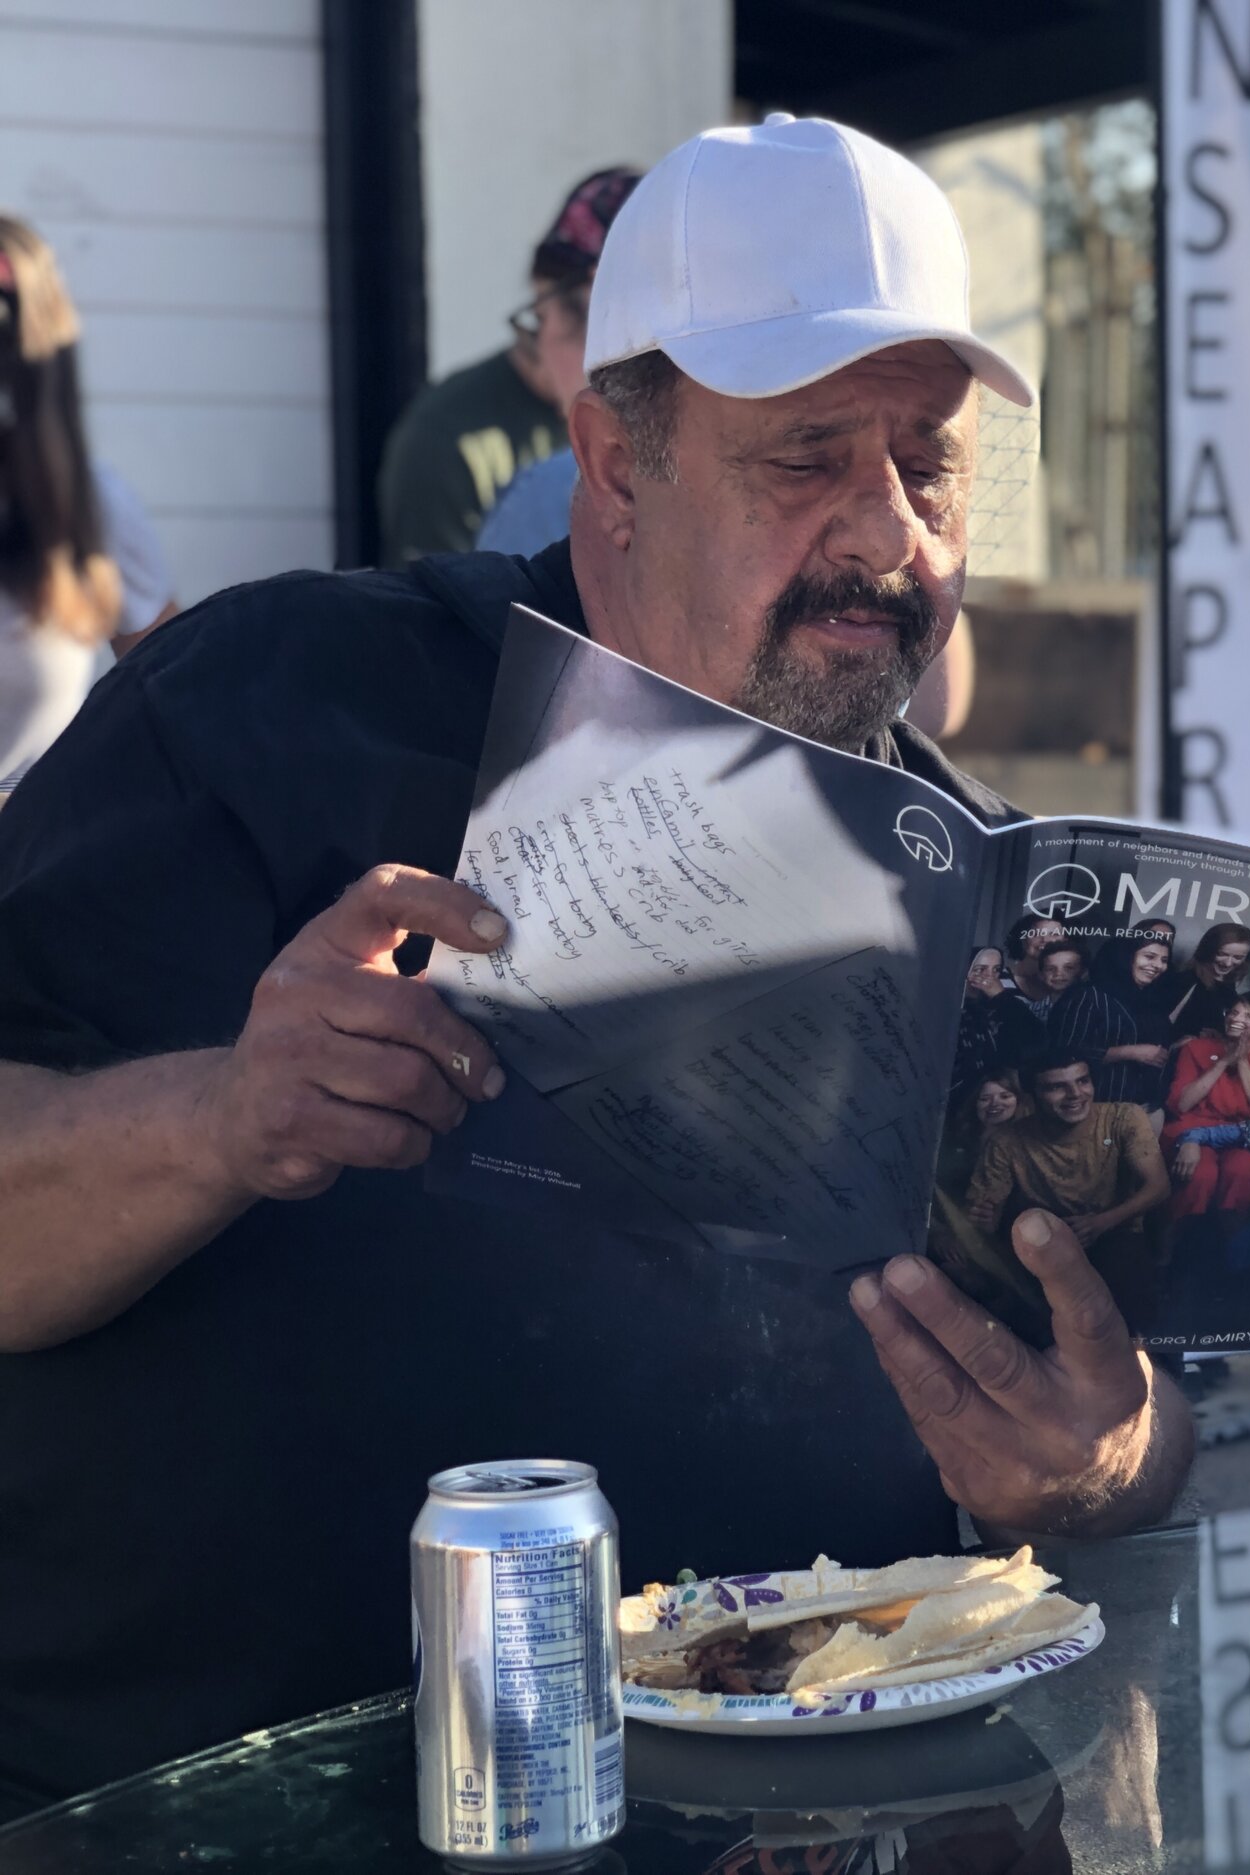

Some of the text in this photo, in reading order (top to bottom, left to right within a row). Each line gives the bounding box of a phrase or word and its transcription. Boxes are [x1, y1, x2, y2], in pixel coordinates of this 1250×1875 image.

[671, 768, 736, 856] trash bags
[1034, 839, 1042, 848] A
[1045, 837, 1104, 847] movement
[1107, 839, 1121, 848] of
[1123, 842, 1179, 856] neighbors
[1182, 848, 1203, 860] and
[1206, 853, 1245, 869] friends
[553, 862, 568, 885] for
[1134, 852, 1198, 871] community
[1200, 861, 1245, 879] through
[1050, 926, 1111, 938] ANNUAL
[1115, 928, 1174, 941] REPORT
[712, 937, 760, 966] girls
[495, 1546, 580, 1563] Nutrition Facts
[496, 1572, 564, 1585] Amount Per Serving
[496, 1587, 526, 1596] Calories
[465, 1774, 473, 1789] 0
